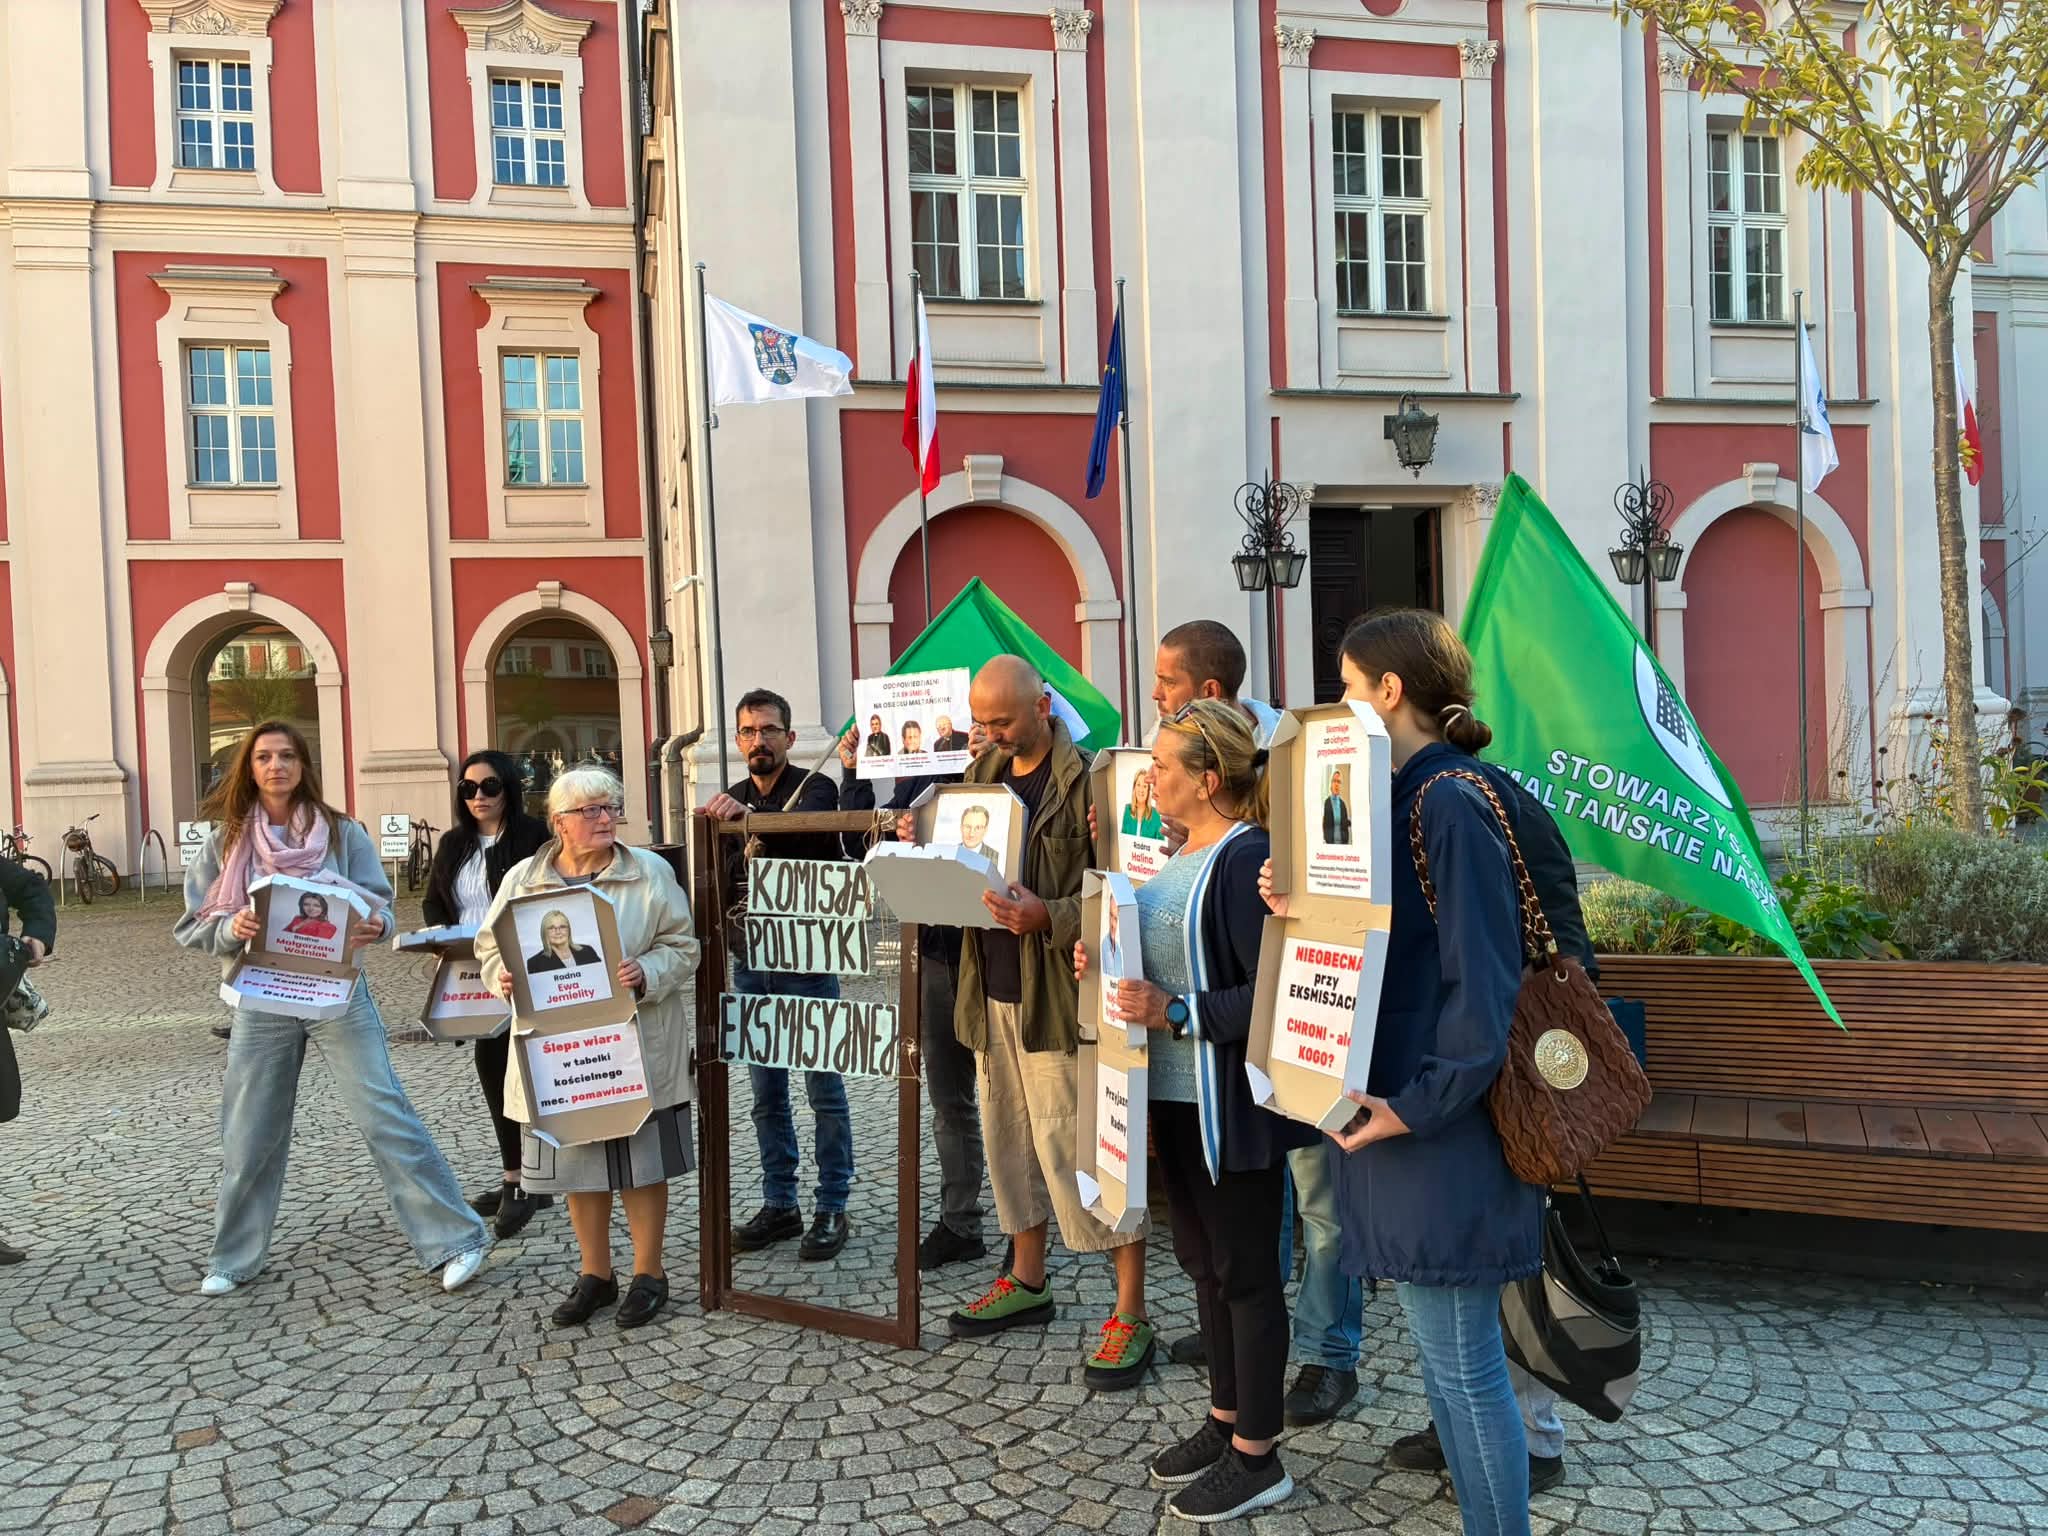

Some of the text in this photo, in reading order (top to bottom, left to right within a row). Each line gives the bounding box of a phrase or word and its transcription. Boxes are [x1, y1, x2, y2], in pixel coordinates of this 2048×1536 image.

[1131, 851, 1154, 865] Halina
[752, 859, 873, 917] KOMISJA
[276, 938, 335, 953] Małgorzata
[747, 917, 870, 974] POLITYKI
[553, 970, 582, 982] Radna
[1313, 973, 1339, 991] przy
[546, 988, 595, 1004] Jemielity
[557, 982, 580, 993] Ewa
[1286, 1018, 1327, 1041] CHRONI
[542, 1033, 622, 1055] Ślepa wiara
[562, 1052, 612, 1068] w tabelki
[1297, 1045, 1335, 1068] KOGO?
[554, 1069, 623, 1087] kościelnego
[540, 1082, 644, 1108] mec. pomawiacza
